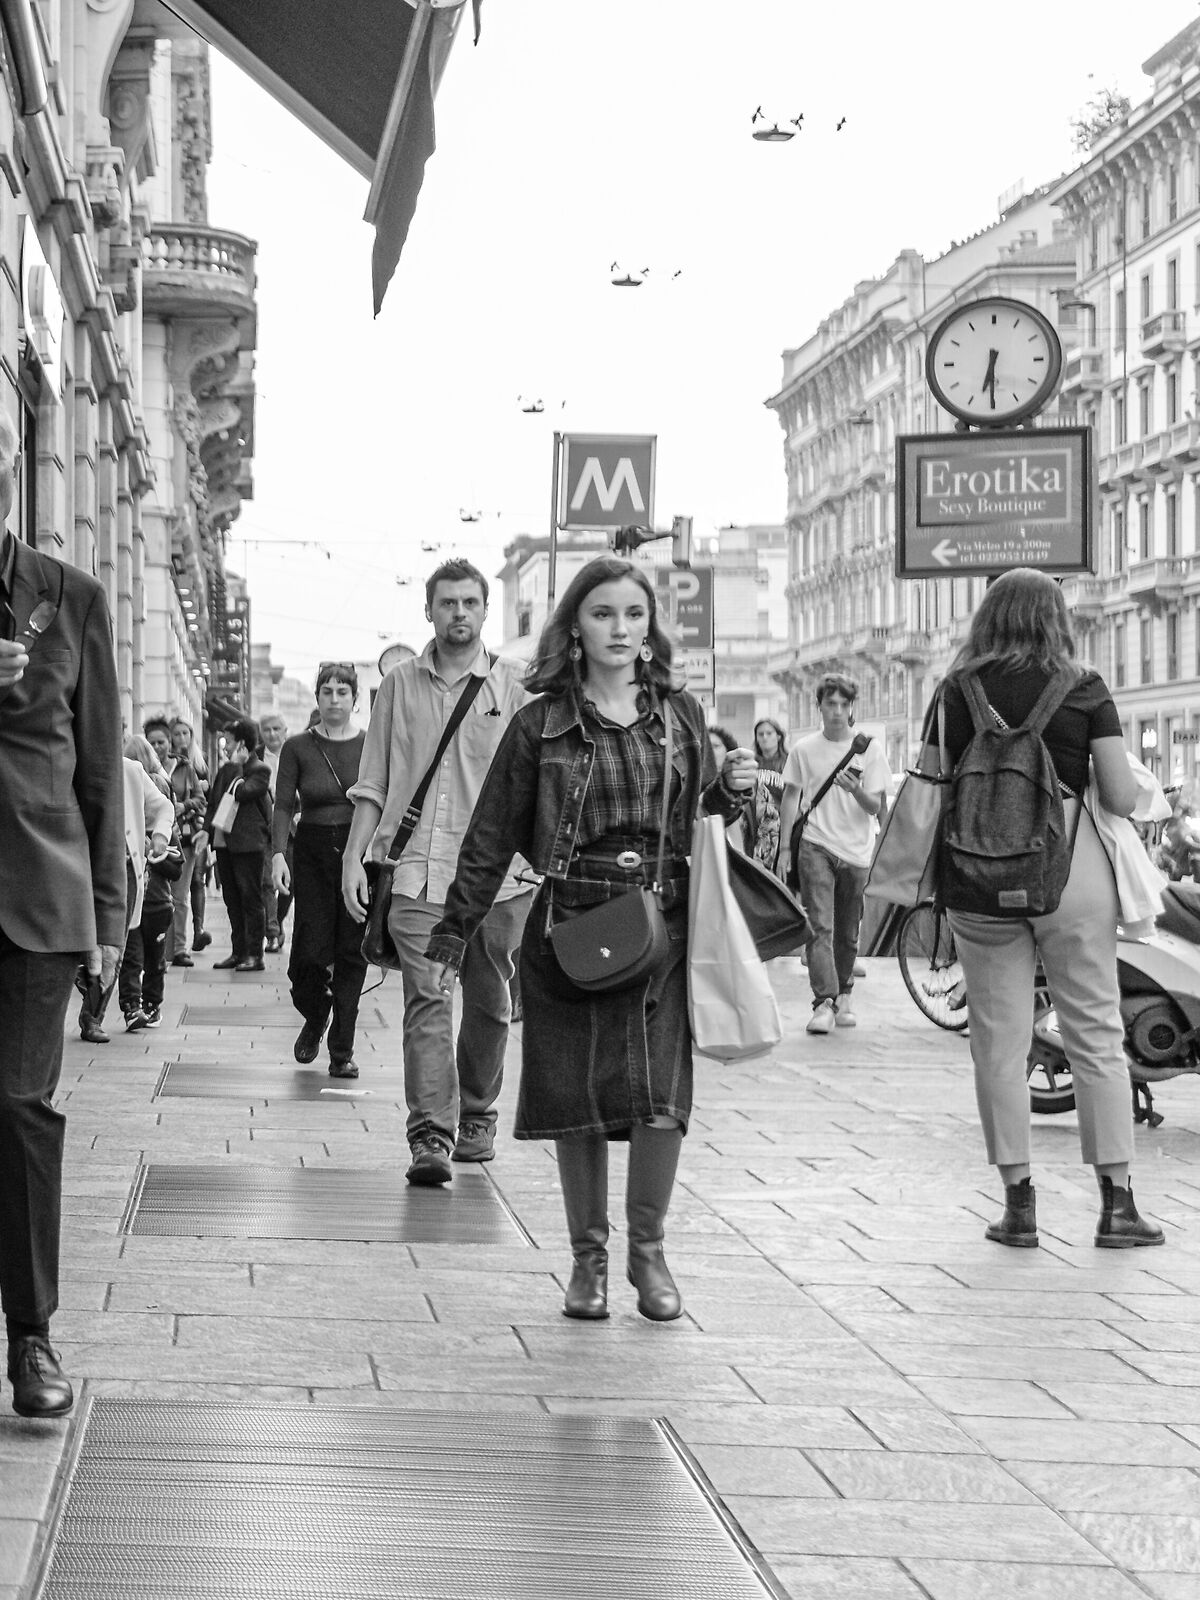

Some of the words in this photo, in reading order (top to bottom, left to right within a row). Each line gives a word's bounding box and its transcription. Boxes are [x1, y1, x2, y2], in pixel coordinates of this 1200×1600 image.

[570, 456, 646, 512] M
[924, 457, 1065, 498] Erotika
[938, 499, 973, 520] Sexy
[977, 497, 1047, 517] Boutique
[956, 541, 972, 551] Via
[1003, 540, 1015, 550] 19
[668, 571, 701, 601] P
